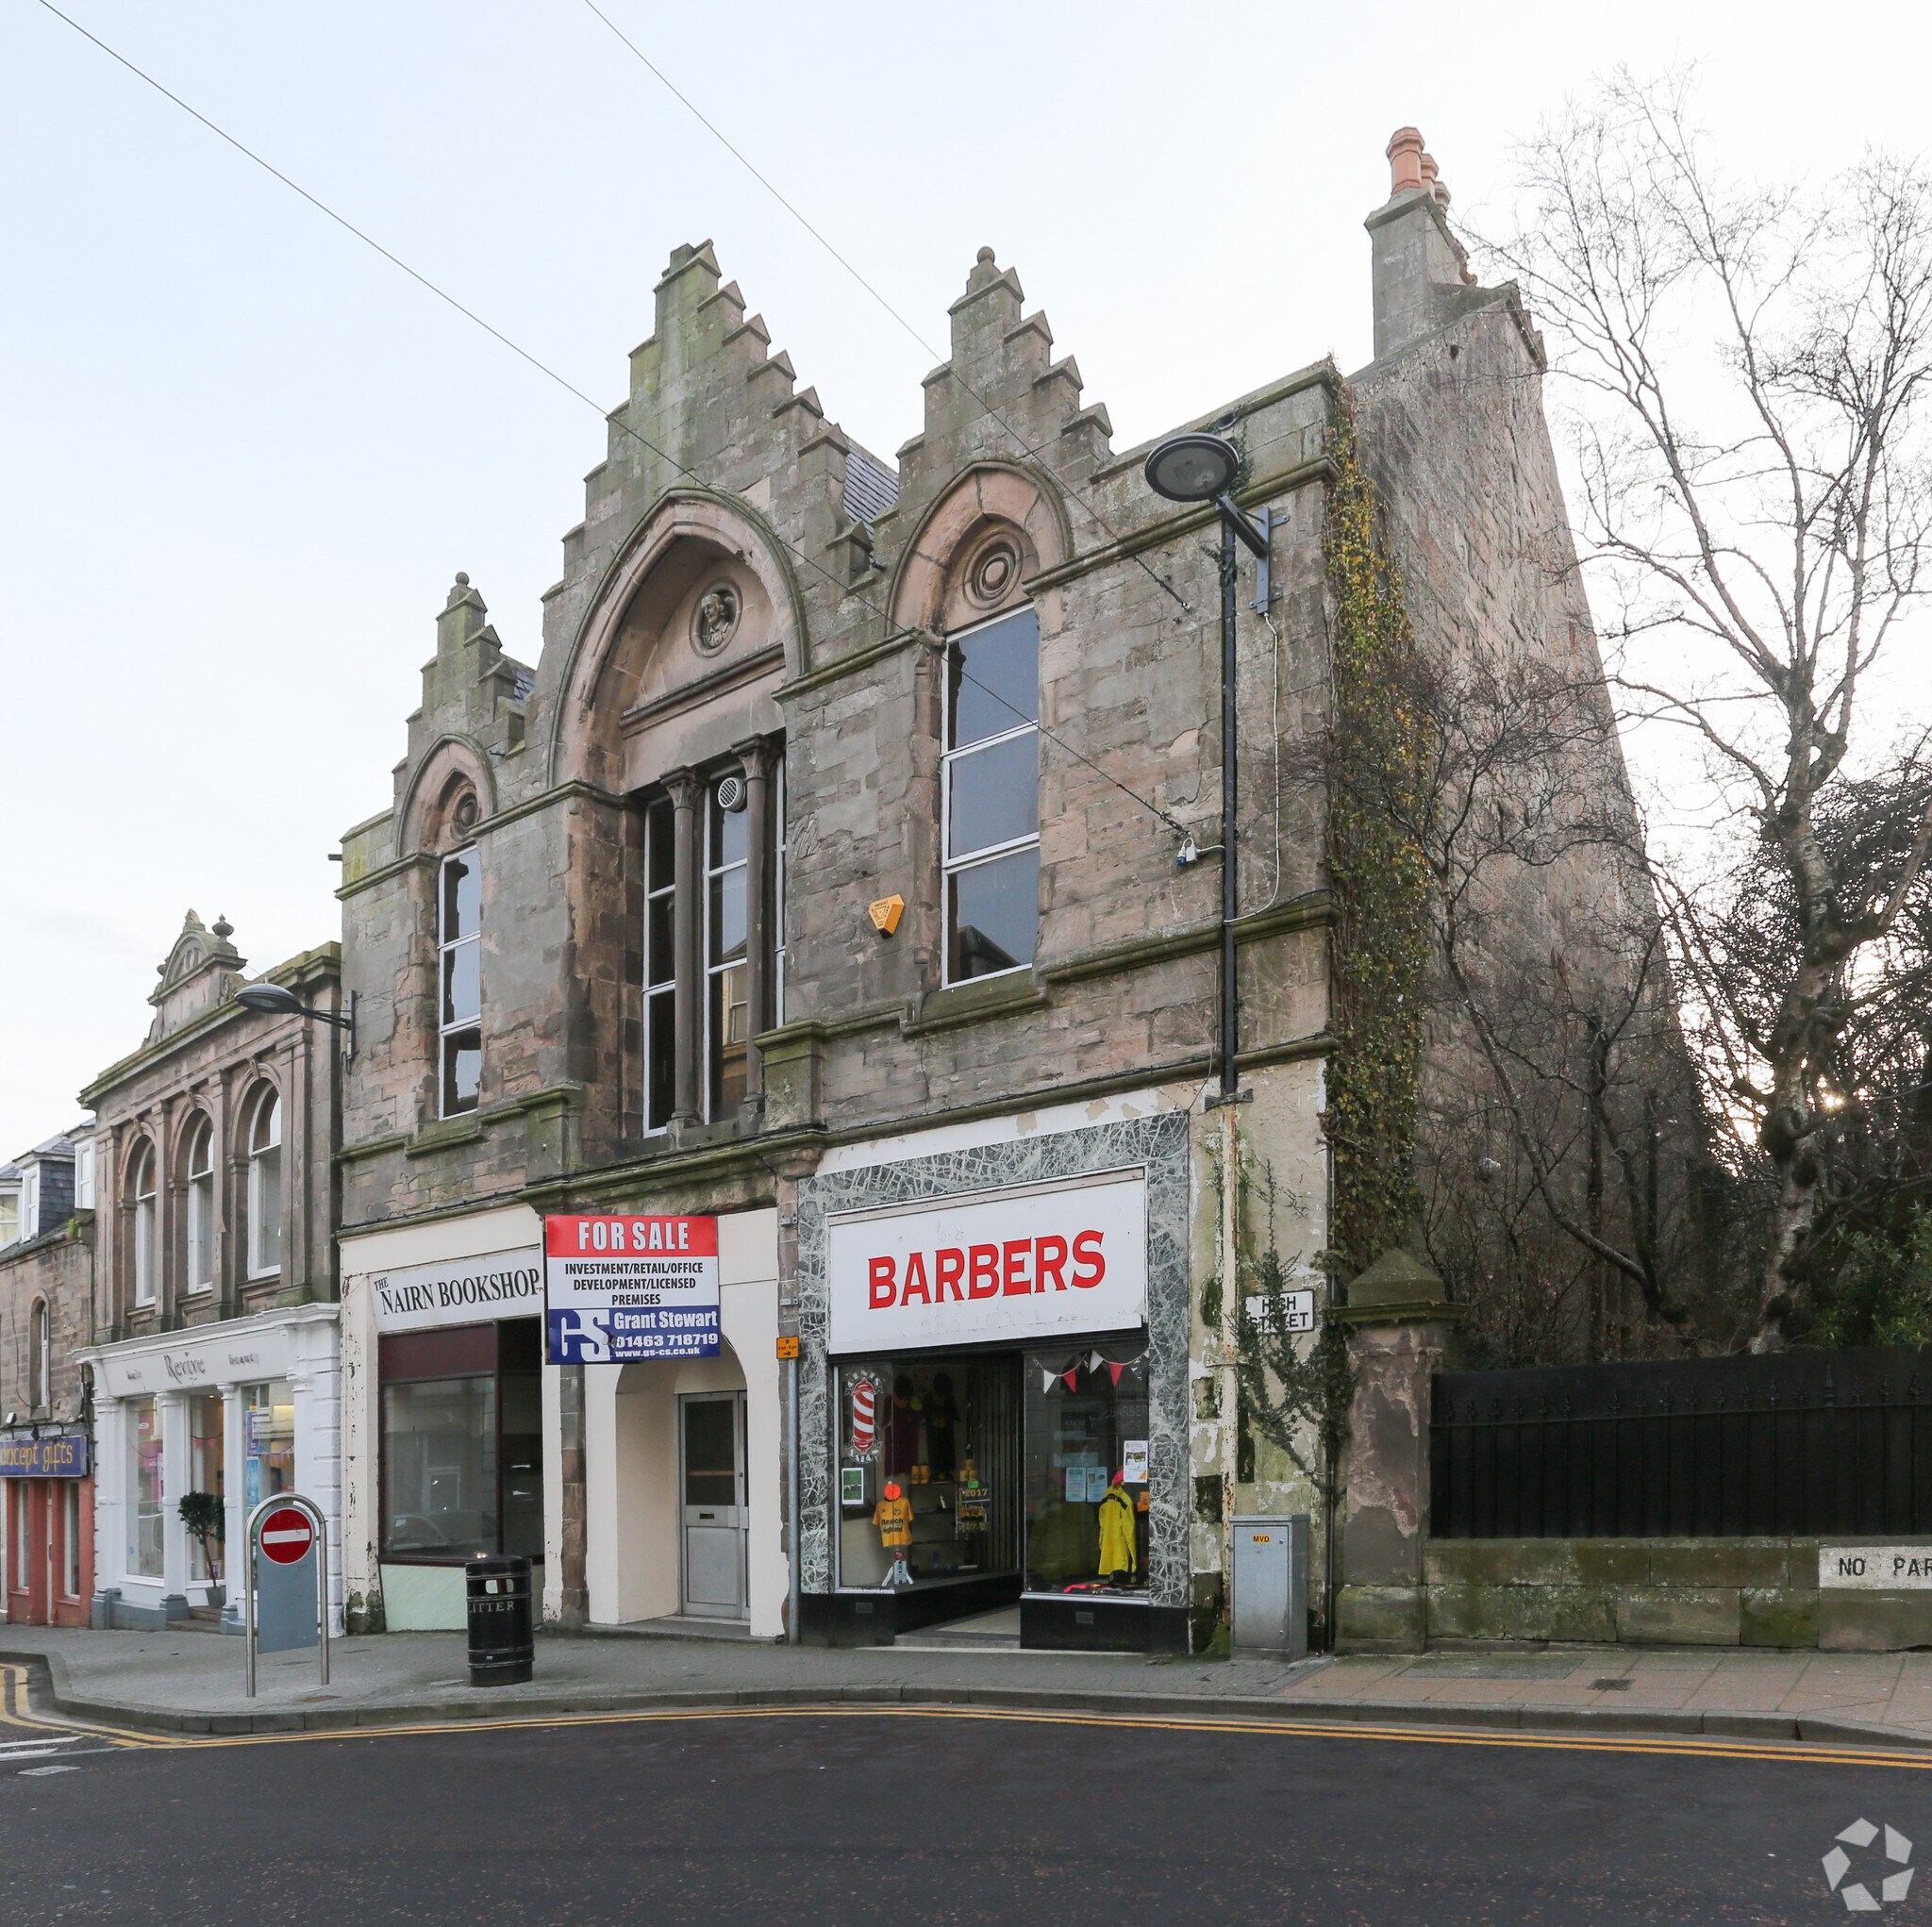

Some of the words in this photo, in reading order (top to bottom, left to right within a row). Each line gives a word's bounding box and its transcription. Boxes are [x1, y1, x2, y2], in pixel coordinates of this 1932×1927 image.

[577, 1221, 625, 1251] FOR
[631, 1221, 690, 1251] SALE
[565, 1262, 704, 1275] INVESTMENT/RETAIL/OFFICE
[867, 1229, 1106, 1310] BARBERS
[374, 1277, 390, 1291] THE
[379, 1284, 435, 1315] NAIRN
[437, 1268, 541, 1307] BOOKSHOP
[574, 1277, 696, 1291] DEVELOPMENT/LICENSED
[611, 1293, 661, 1306] PREMISES
[614, 1312, 658, 1330] Grant
[658, 1310, 718, 1329] Stewart
[615, 1335, 664, 1349] 01463
[667, 1333, 719, 1346] 718719
[614, 1346, 701, 1358] www.gs-cs.co.uk
[42, 1442, 73, 1473] gifts
[964, 1488, 988, 1498] 2017
[1839, 1557, 1866, 1576] NO
